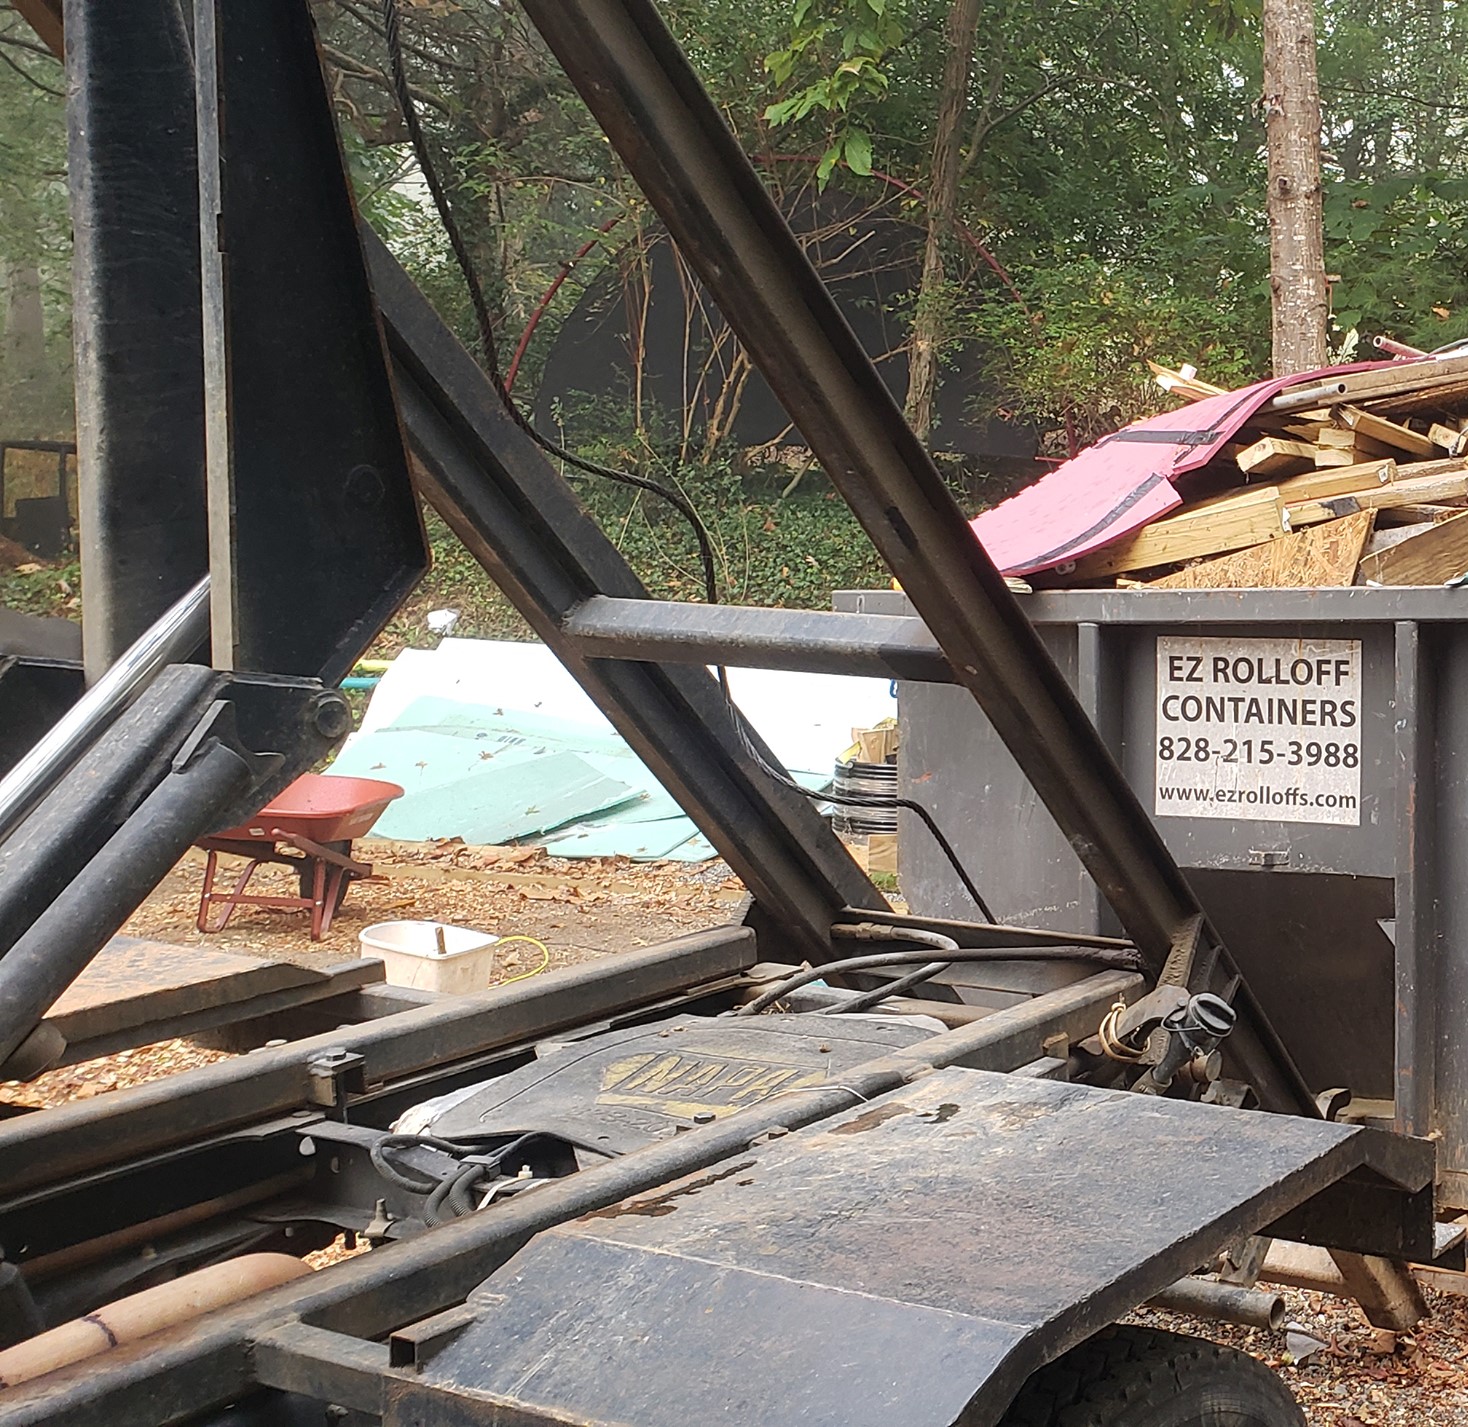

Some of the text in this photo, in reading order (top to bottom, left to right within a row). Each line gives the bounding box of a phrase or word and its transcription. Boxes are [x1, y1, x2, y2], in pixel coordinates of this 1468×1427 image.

[1168, 655, 1350, 686] EZ ROLLOFF
[1162, 694, 1356, 727] CONTAINERS
[1158, 736, 1359, 768] 828-215-3988
[1159, 785, 1357, 809] www.ezrolloffs.com
[622, 1054, 801, 1102] NAPA
